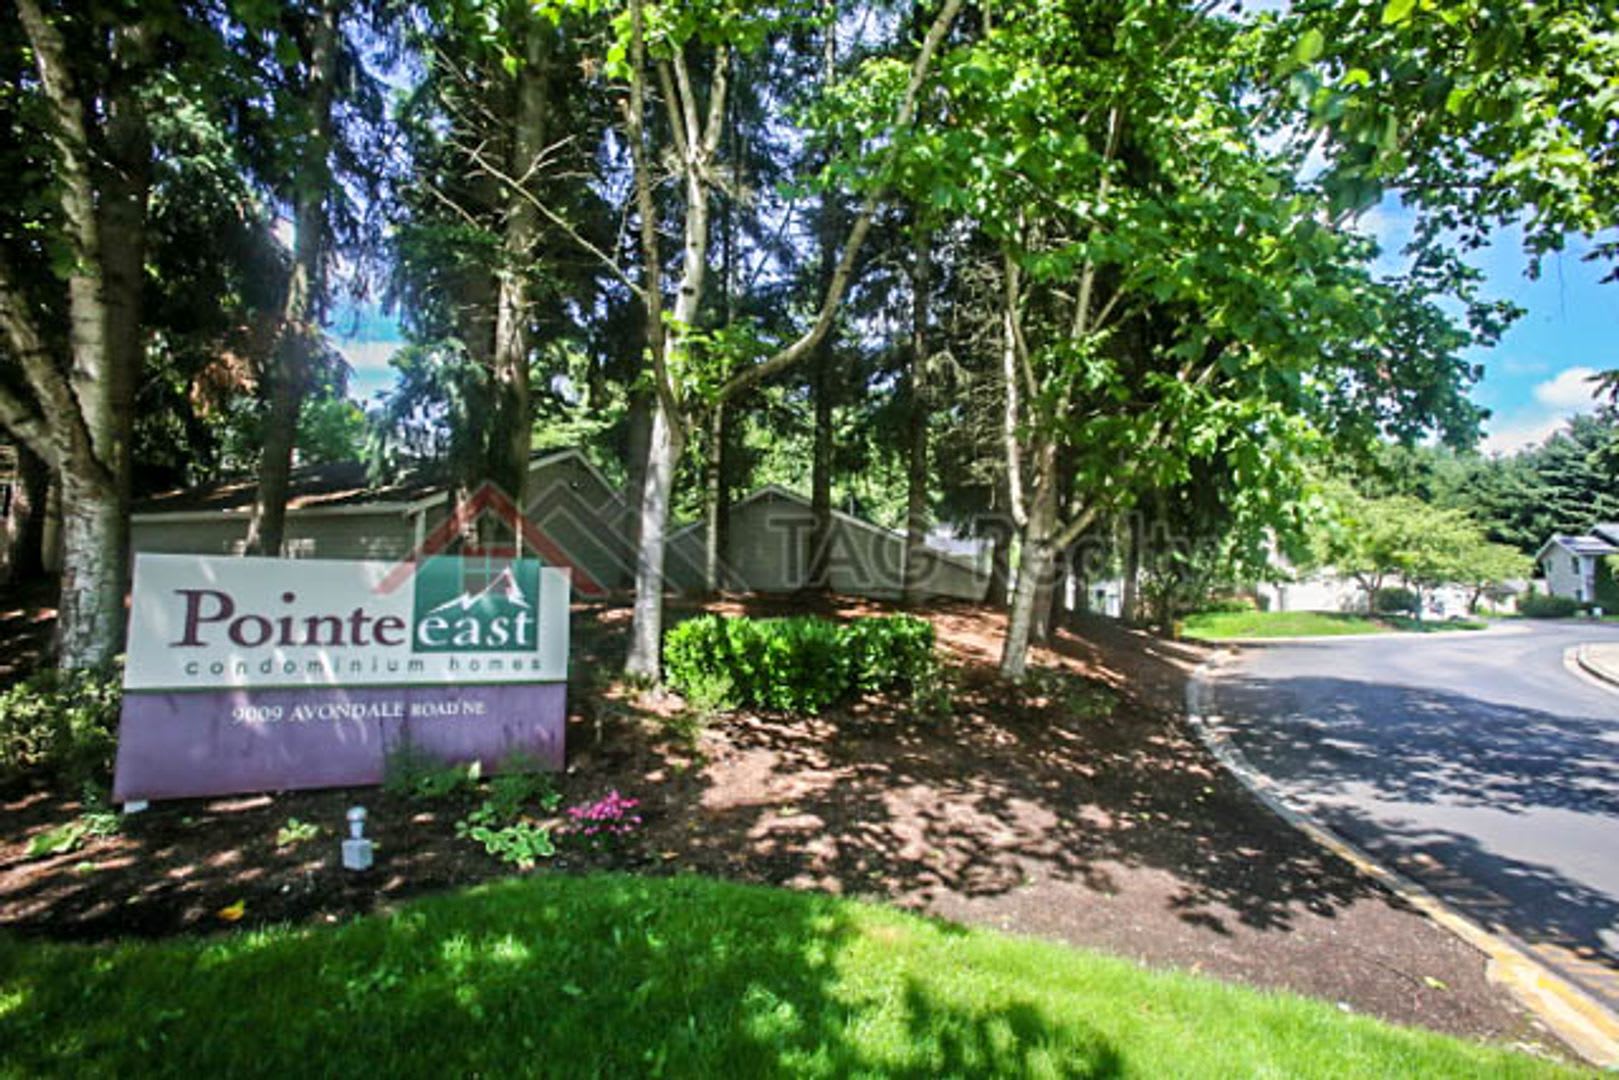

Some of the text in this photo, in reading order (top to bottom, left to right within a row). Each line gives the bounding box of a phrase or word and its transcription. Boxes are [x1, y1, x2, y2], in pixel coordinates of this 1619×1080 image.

[169, 588, 535, 649] Pointe east
[184, 656, 542, 676] condominium homes
[231, 705, 284, 726] 9009
[288, 701, 404, 721] AVONDALE
[462, 701, 487, 715] NE
